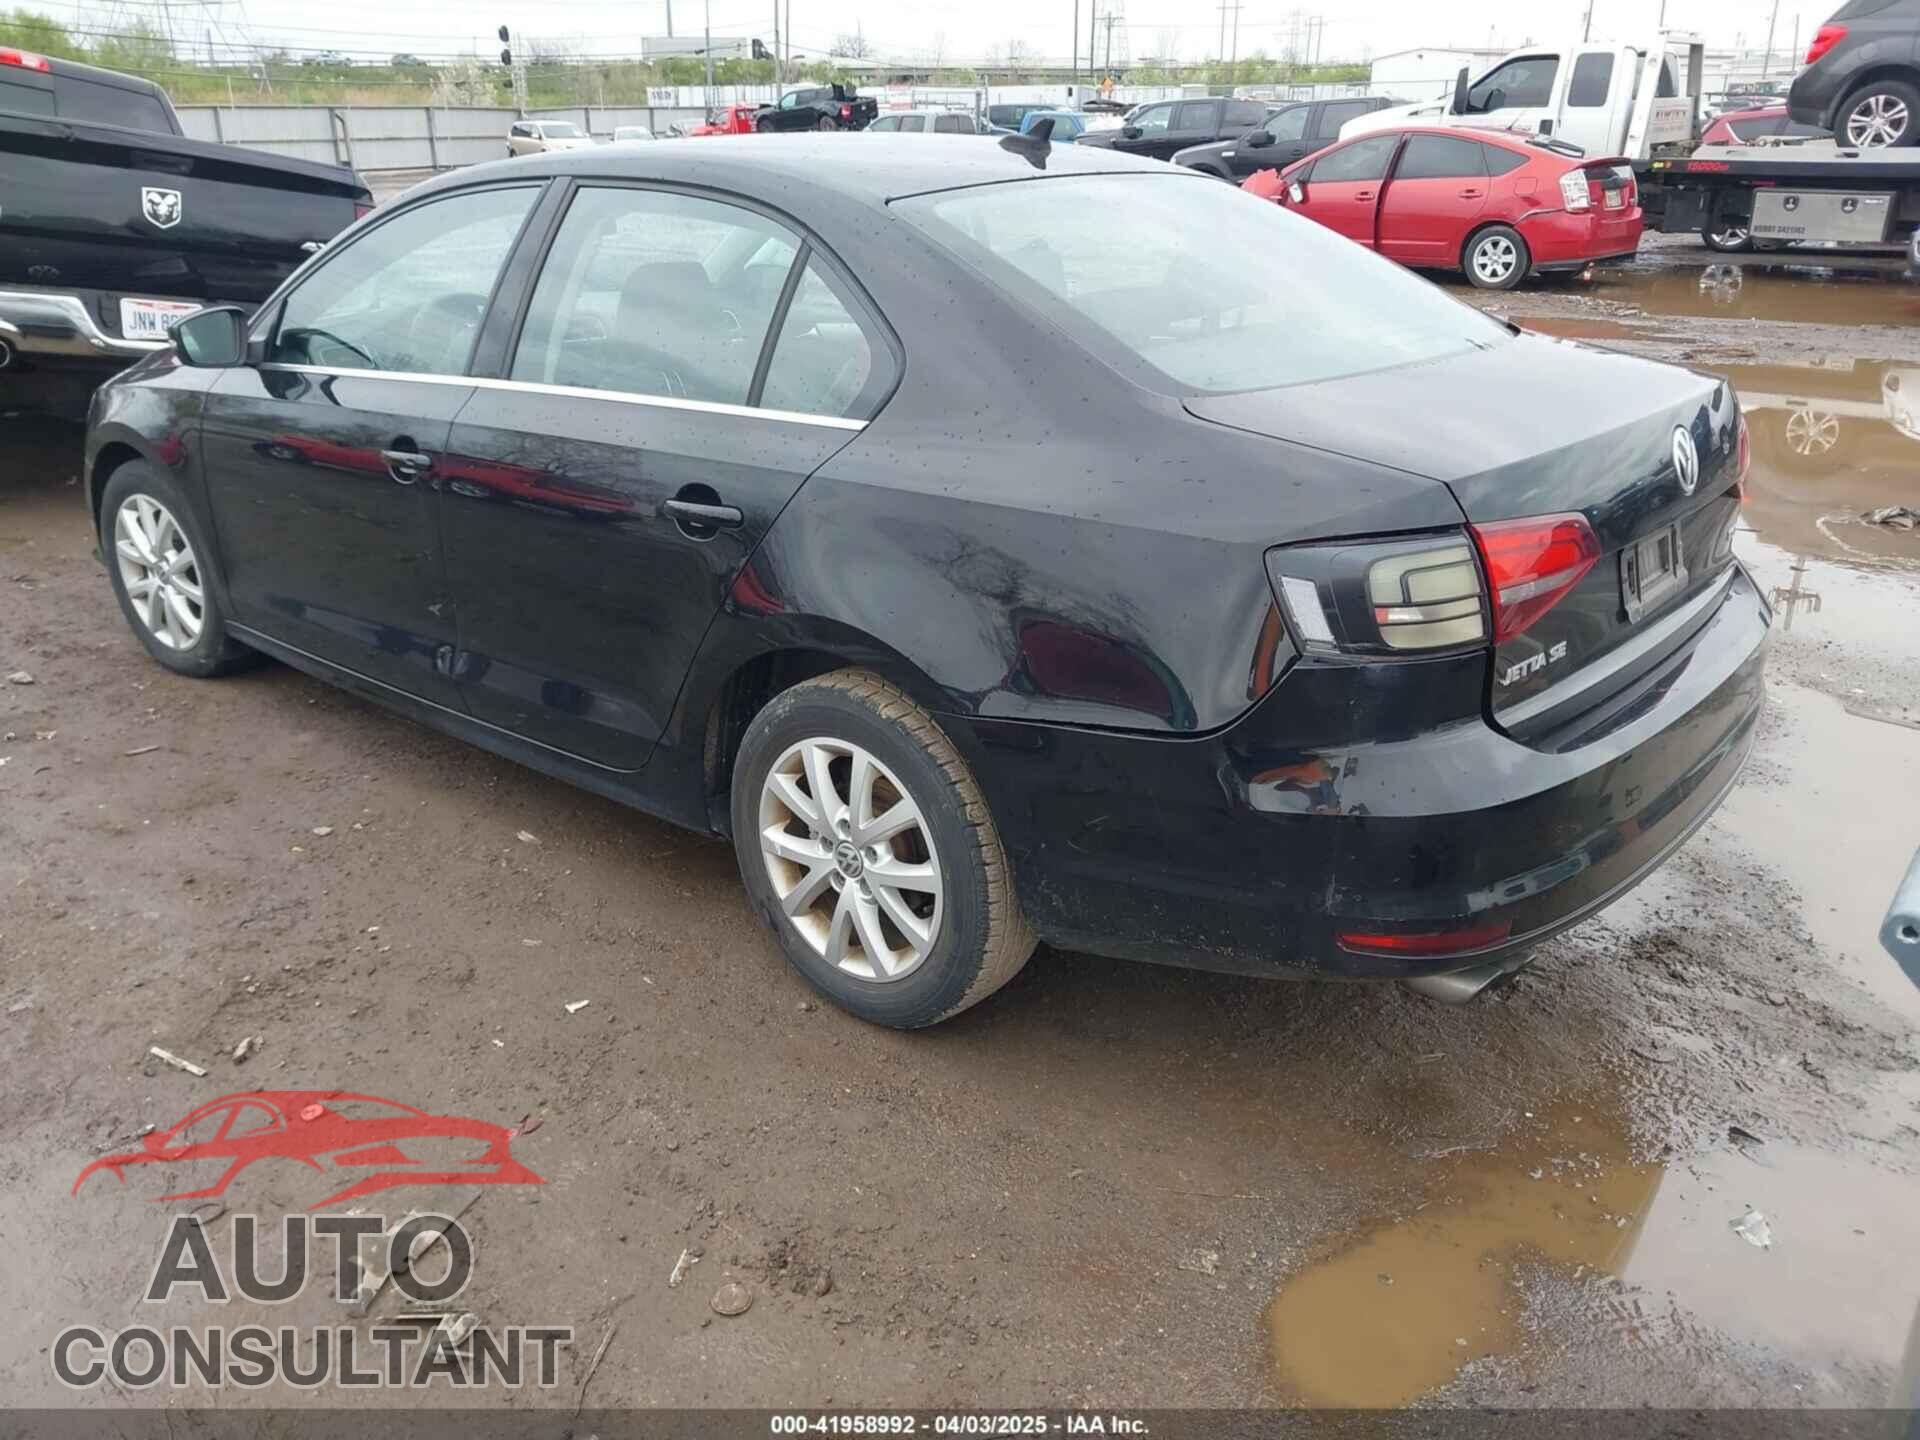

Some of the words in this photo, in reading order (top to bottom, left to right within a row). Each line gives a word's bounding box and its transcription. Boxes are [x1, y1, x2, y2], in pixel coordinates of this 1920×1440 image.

[129, 311, 156, 331] JNW
[1498, 652, 1547, 686] JETTA
[1549, 640, 1567, 663] SE
